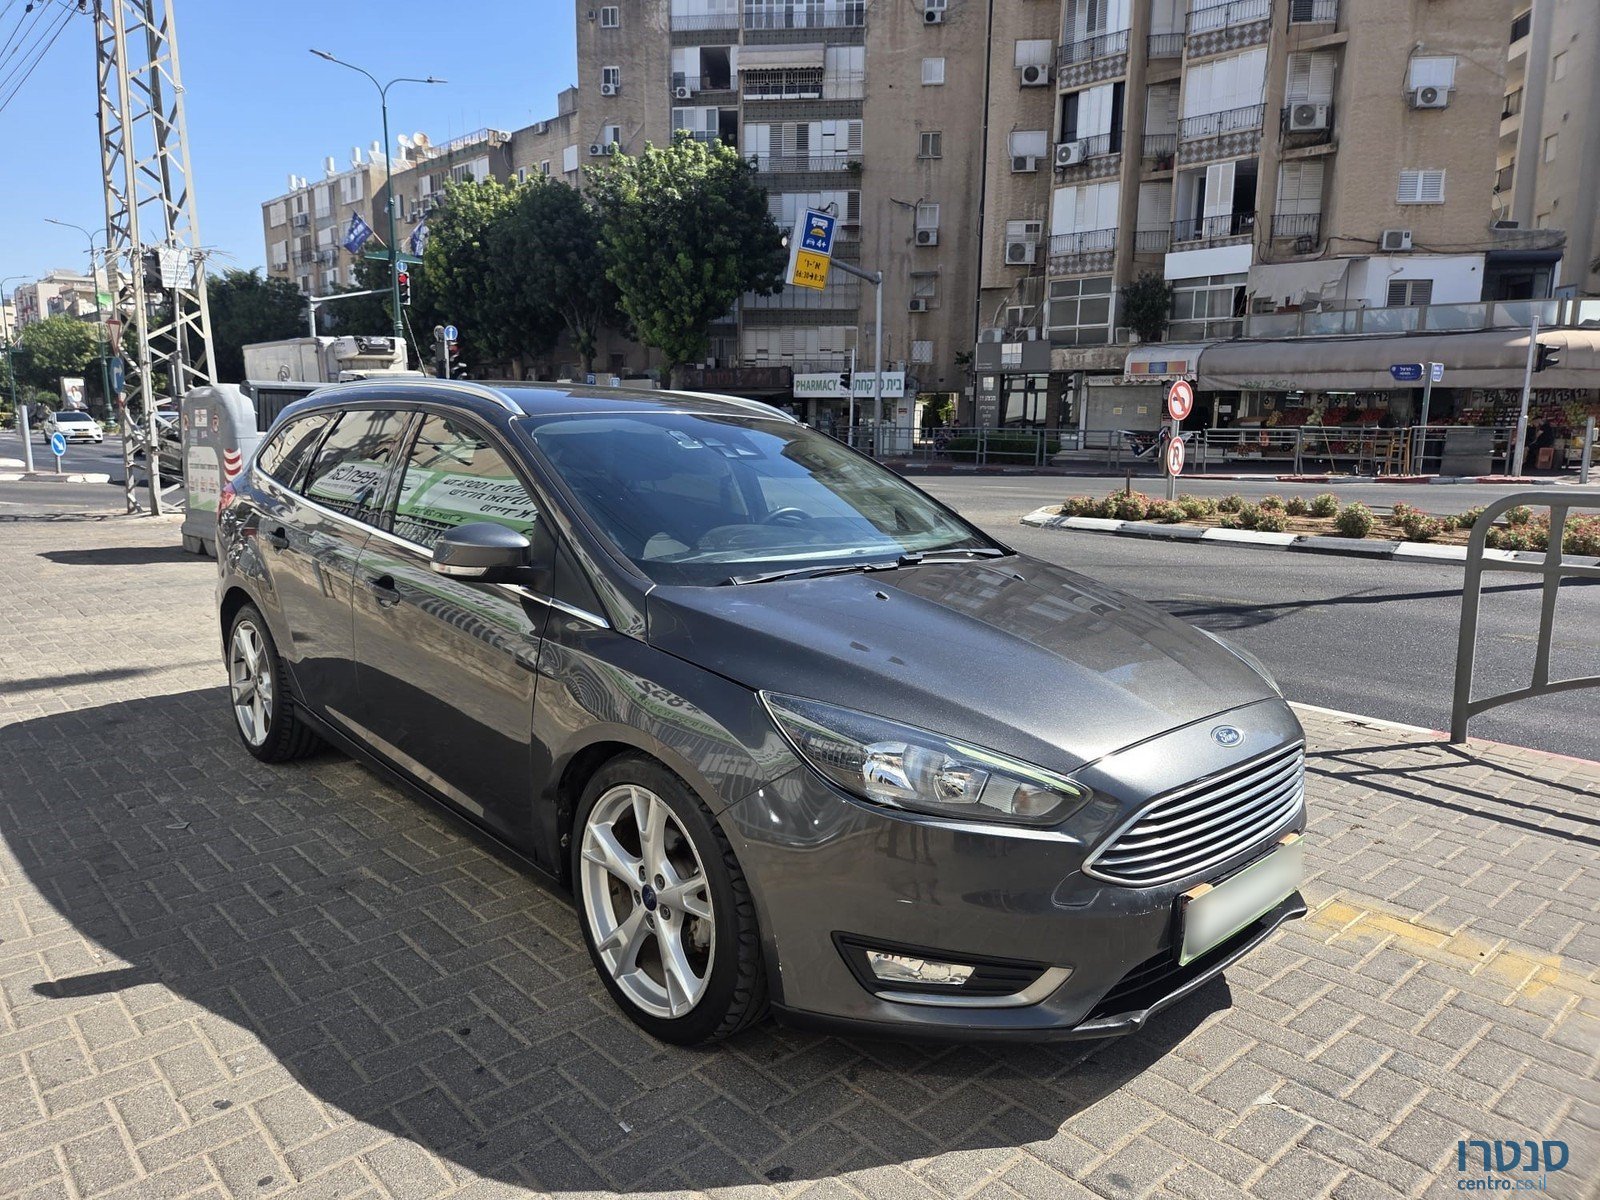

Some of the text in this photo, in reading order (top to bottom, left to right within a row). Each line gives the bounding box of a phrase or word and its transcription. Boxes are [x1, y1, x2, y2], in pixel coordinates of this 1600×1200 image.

[816, 239, 826, 248] 4+
[795, 379, 837, 391] PHARMACY
[886, 378, 902, 391] בית
[1218, 731, 1239, 742] Ford
